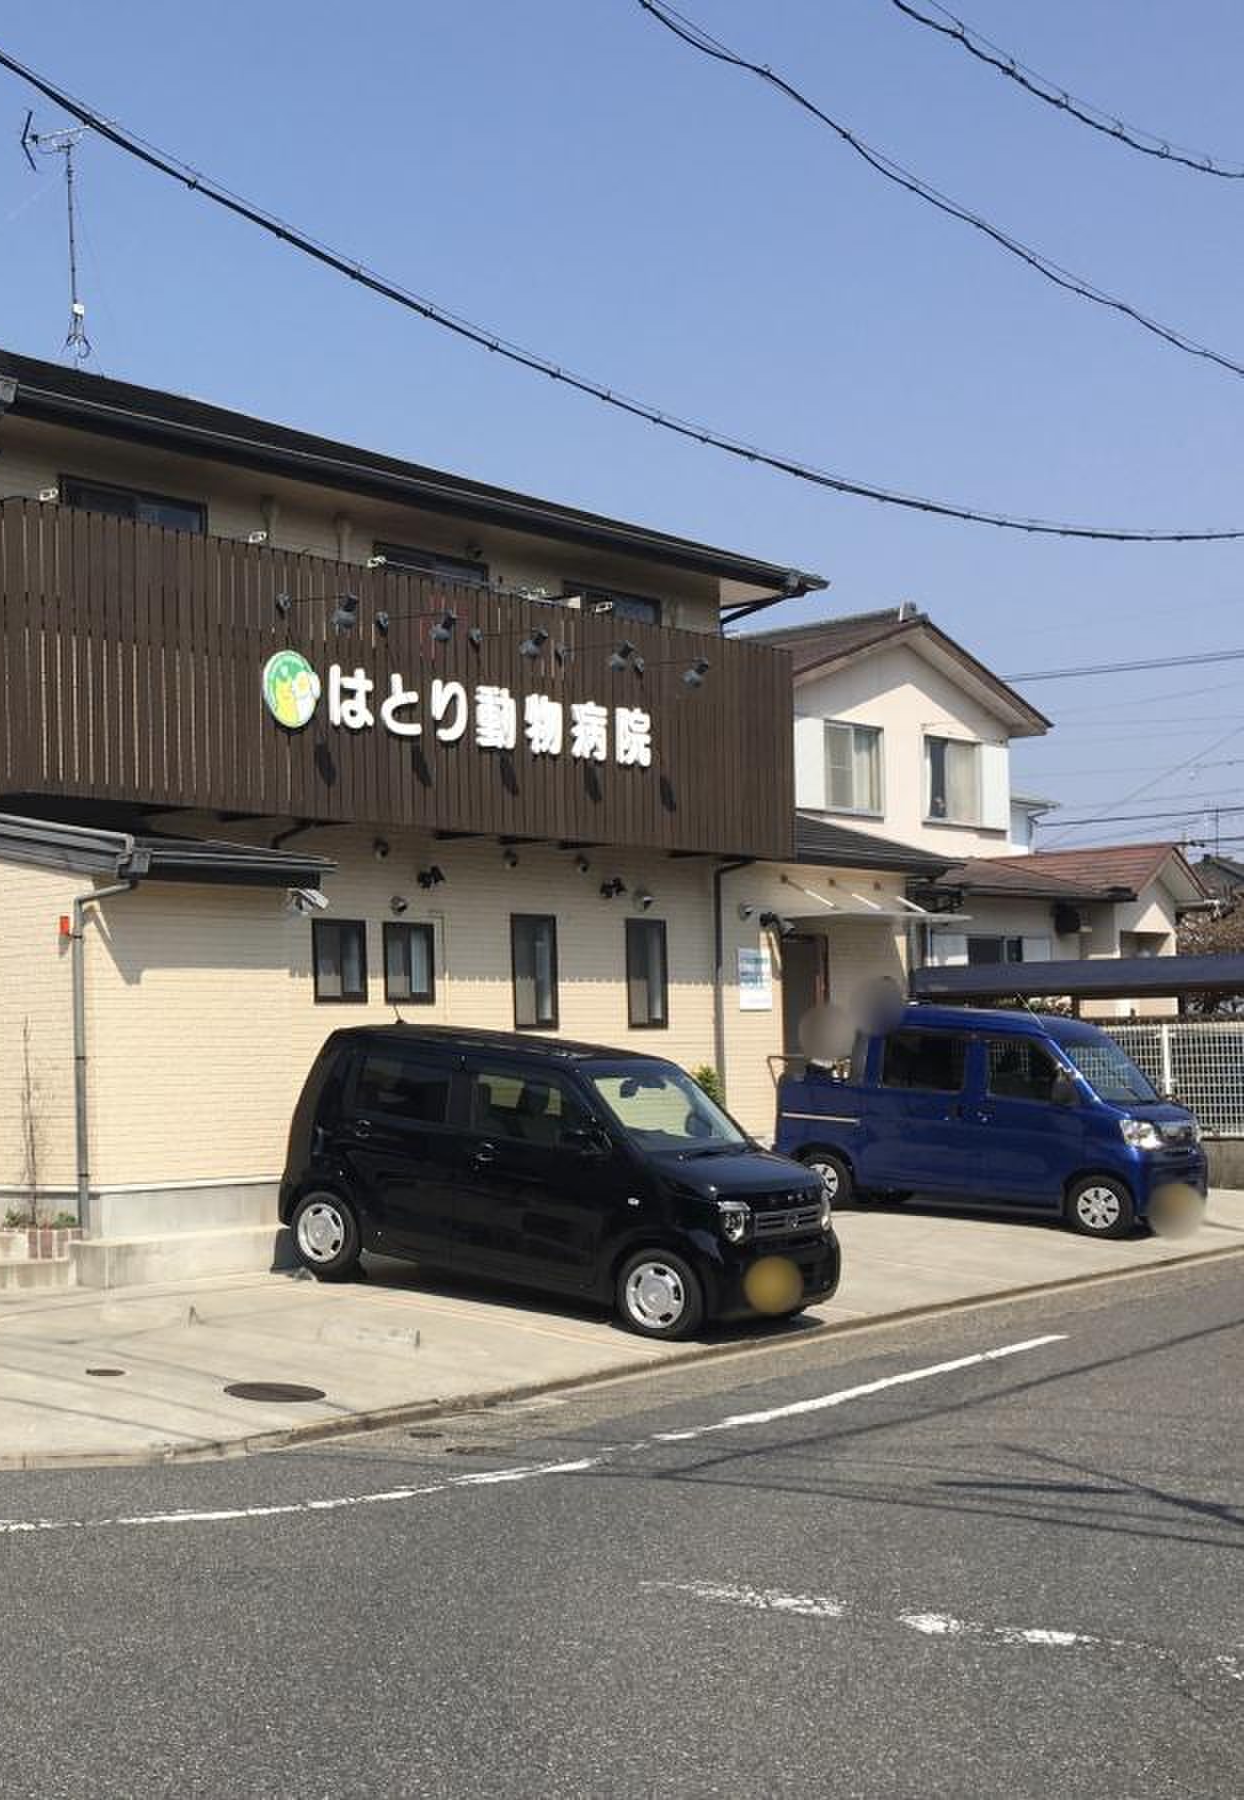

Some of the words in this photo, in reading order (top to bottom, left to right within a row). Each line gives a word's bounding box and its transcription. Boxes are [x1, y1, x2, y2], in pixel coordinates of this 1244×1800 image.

[328, 662, 653, 768] はとり動物病院
